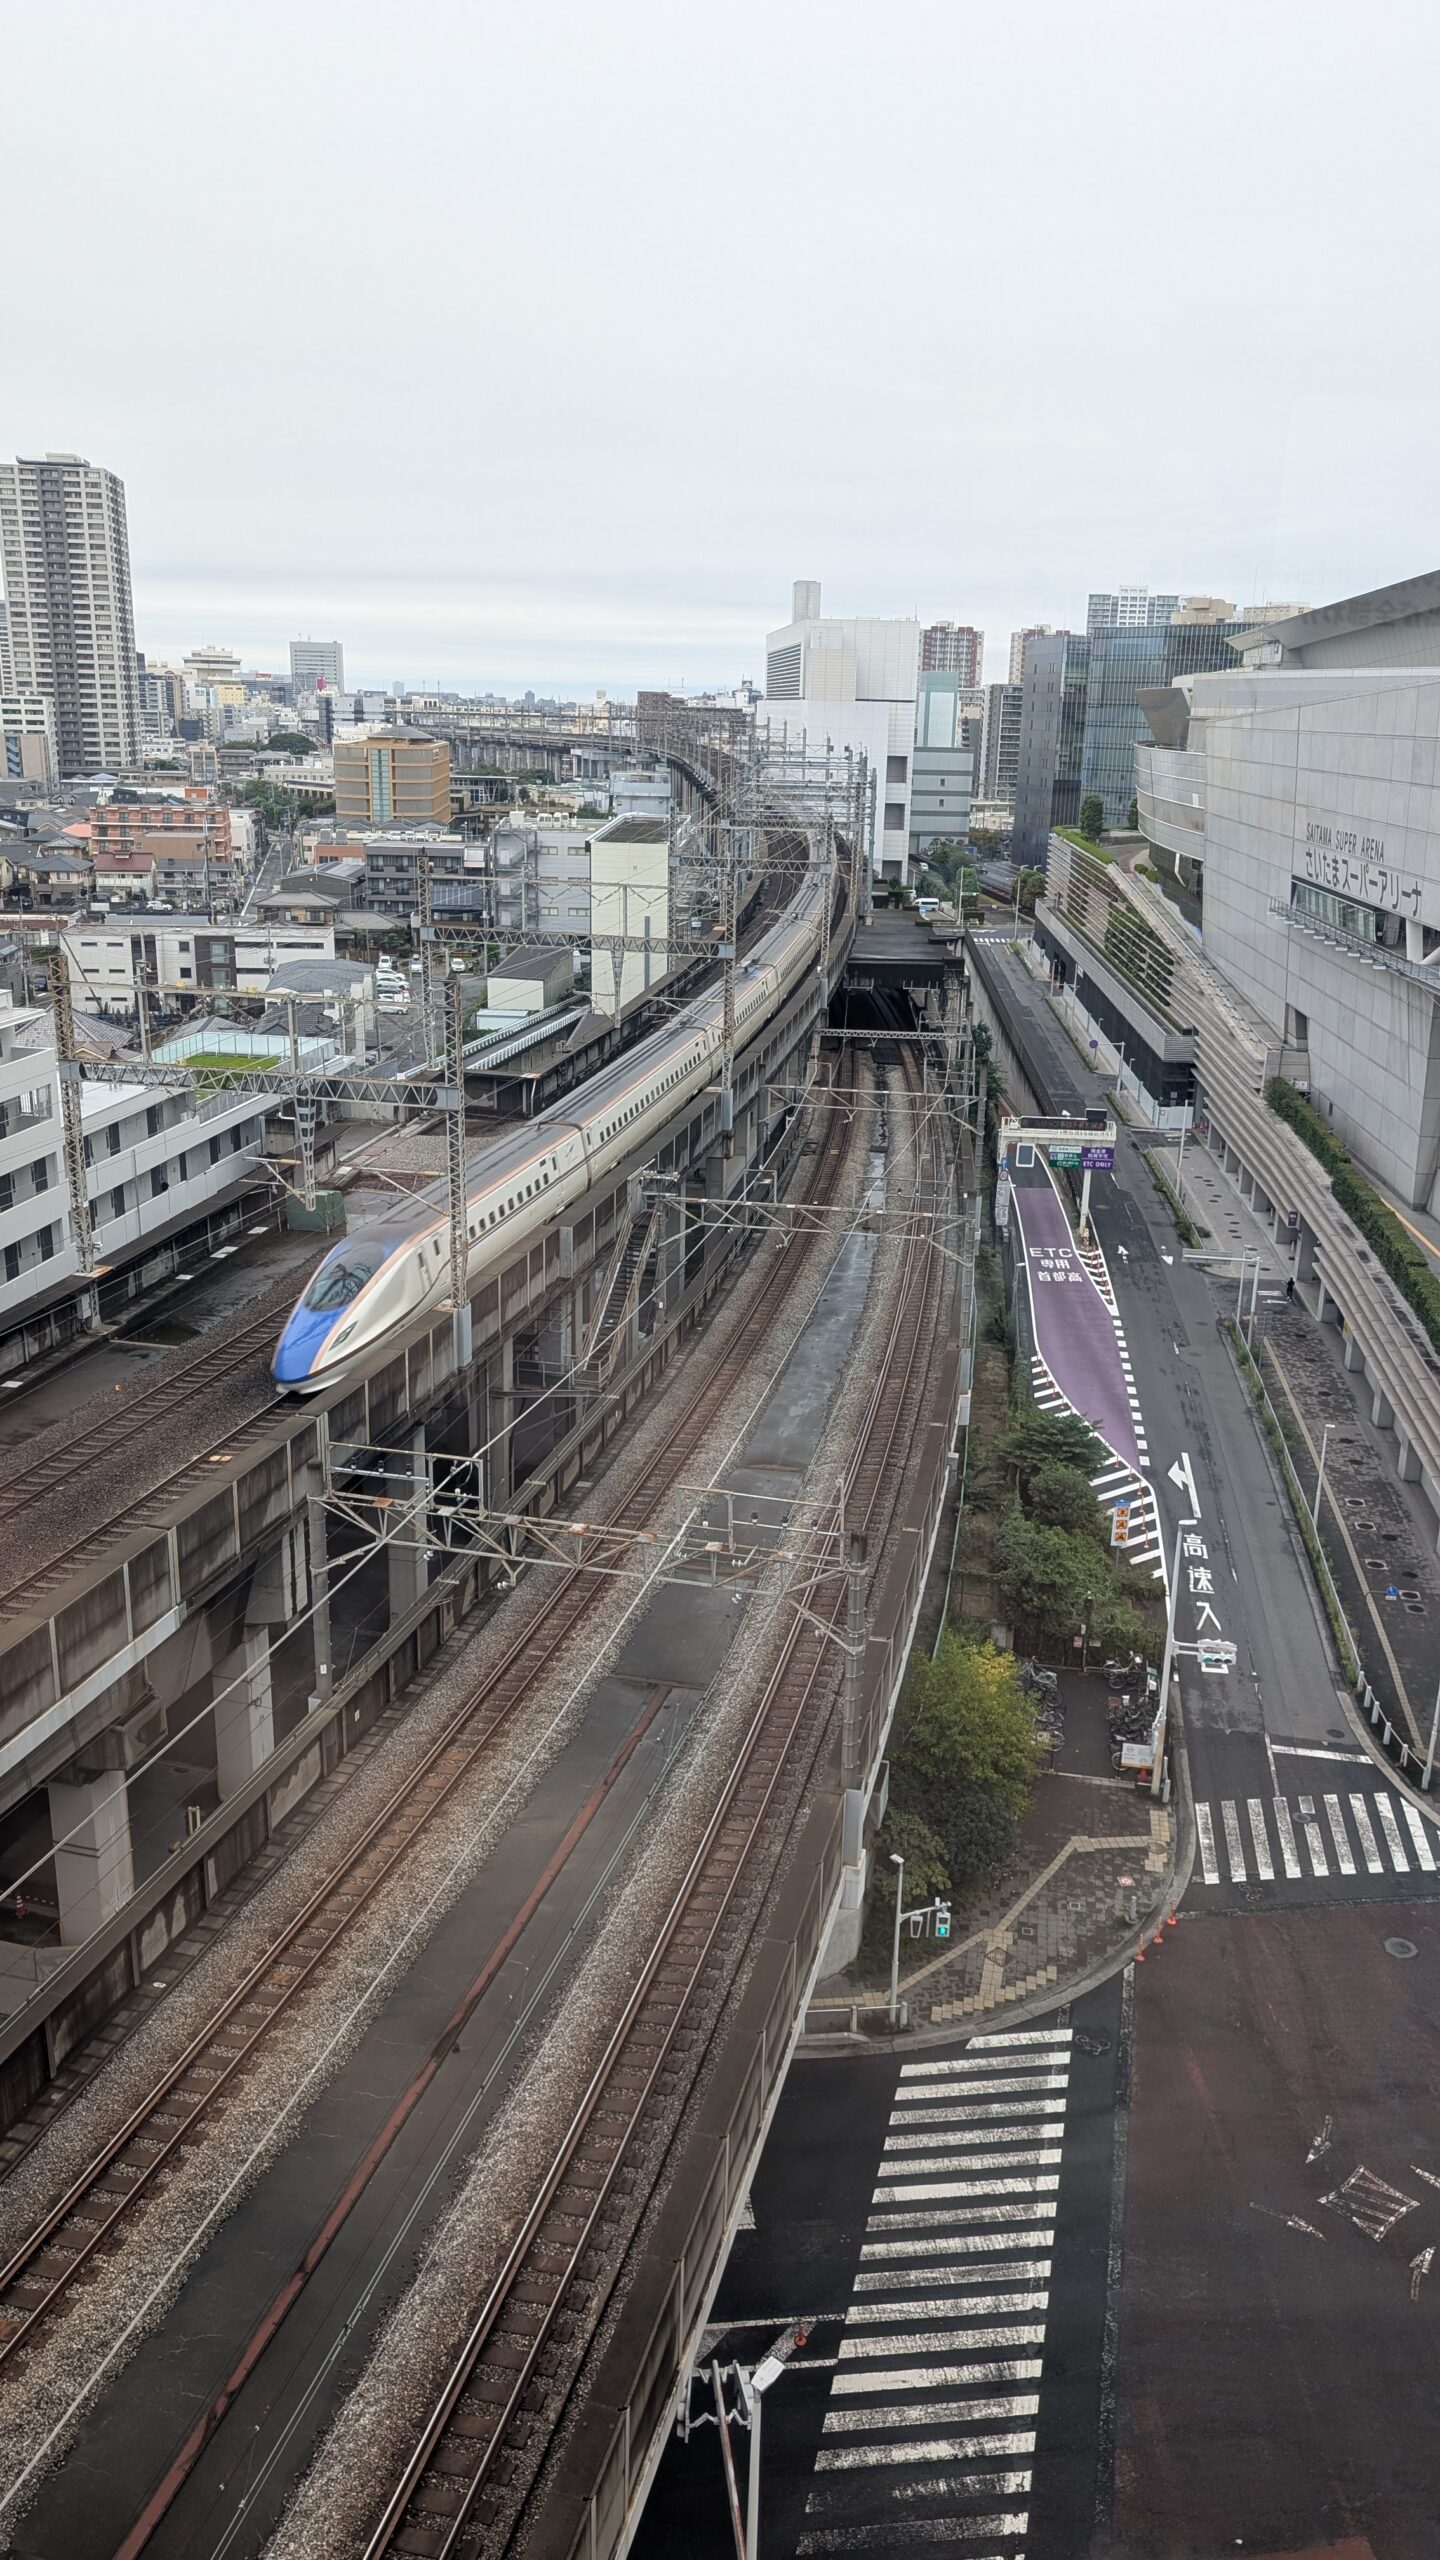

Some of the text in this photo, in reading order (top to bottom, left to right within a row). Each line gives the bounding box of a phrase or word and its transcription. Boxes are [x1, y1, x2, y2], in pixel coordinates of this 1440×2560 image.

[1306, 822, 1384, 863] SAITAMA SUPER ARENA
[1306, 847, 1421, 917] さいたまスーパーアリーナ
[1029, 1248, 1073, 1257] ETC
[1040, 1259, 1070, 1269] 専用
[1037, 1271, 1083, 1282] 首都高
